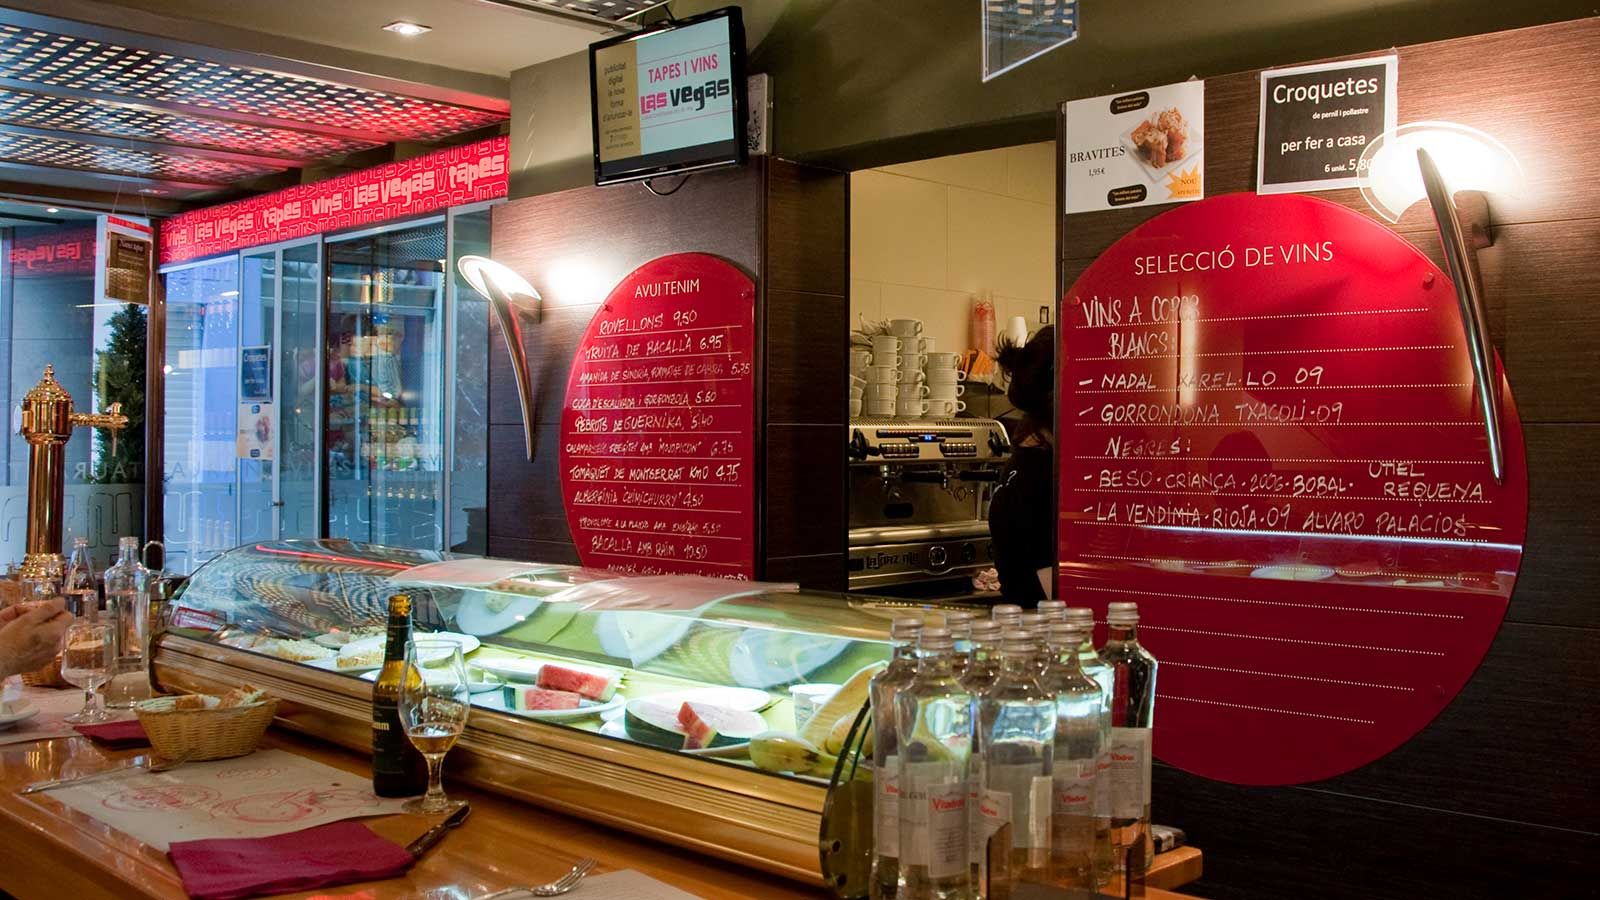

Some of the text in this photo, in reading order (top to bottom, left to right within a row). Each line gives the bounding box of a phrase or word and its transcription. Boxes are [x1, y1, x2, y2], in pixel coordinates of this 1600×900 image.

[648, 63, 681, 83] TAPES
[691, 54, 718, 73] VINS
[1273, 77, 1378, 104] Croquetes
[1312, 112, 1321, 120] de
[1321, 109, 1339, 120] pernil
[1343, 107, 1369, 118] pollastre
[1070, 146, 1126, 163] BRAVITES
[1281, 134, 1366, 155] per fer a casa
[1324, 164, 1331, 173] 6
[1331, 164, 1347, 172] unid.
[263, 201, 302, 232] tapes
[449, 154, 505, 192] tapes
[1134, 241, 1334, 276] SELECCIÓ DE VINS
[635, 278, 700, 298] AVUI TENIM
[1128, 296, 1142, 323] A
[599, 313, 664, 335] ROVELLONS
[626, 343, 640, 358] DE
[699, 334, 724, 350] 6.95
[1101, 373, 1157, 390] NADAL
[1295, 366, 1324, 386] 09
[1101, 403, 1220, 425] GORRONDONA
[613, 467, 624, 480] DE
[629, 465, 686, 481] MONTSERRAT
[1097, 502, 1117, 522] LA
[1303, 511, 1365, 534] ALVARO
